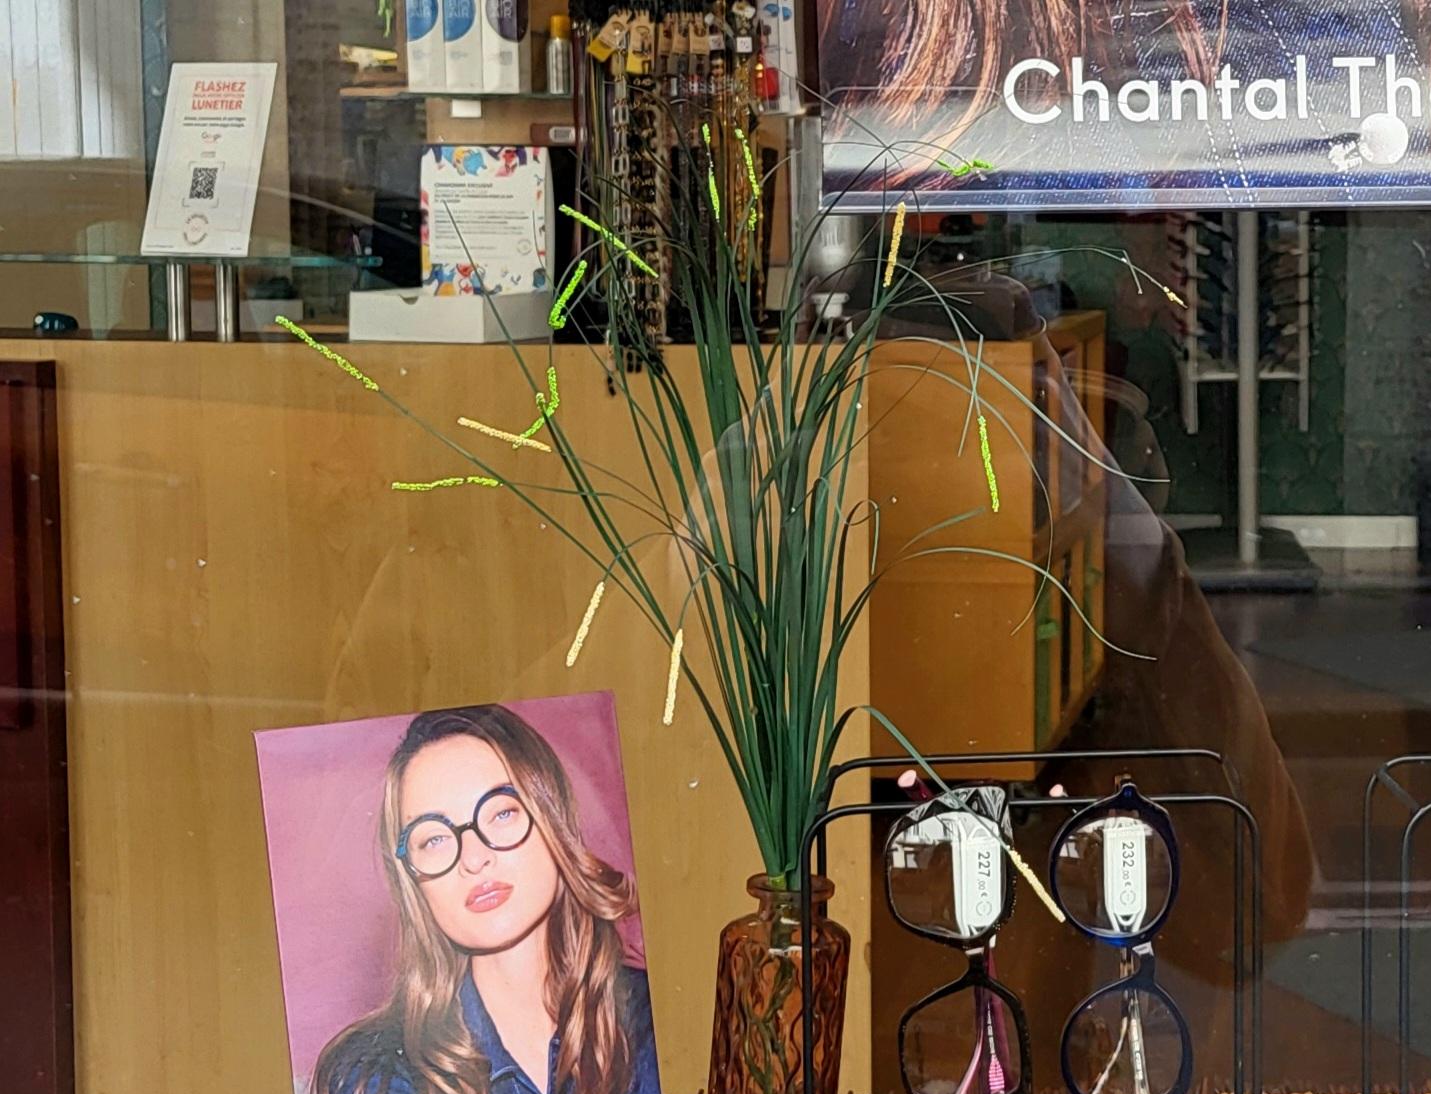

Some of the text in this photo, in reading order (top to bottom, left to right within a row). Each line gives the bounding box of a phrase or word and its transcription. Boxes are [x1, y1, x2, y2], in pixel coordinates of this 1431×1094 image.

[194, 80, 247, 92] FLASHEZ
[1003, 55, 1308, 125] Chantal
[191, 99, 243, 111] LUNETIER
